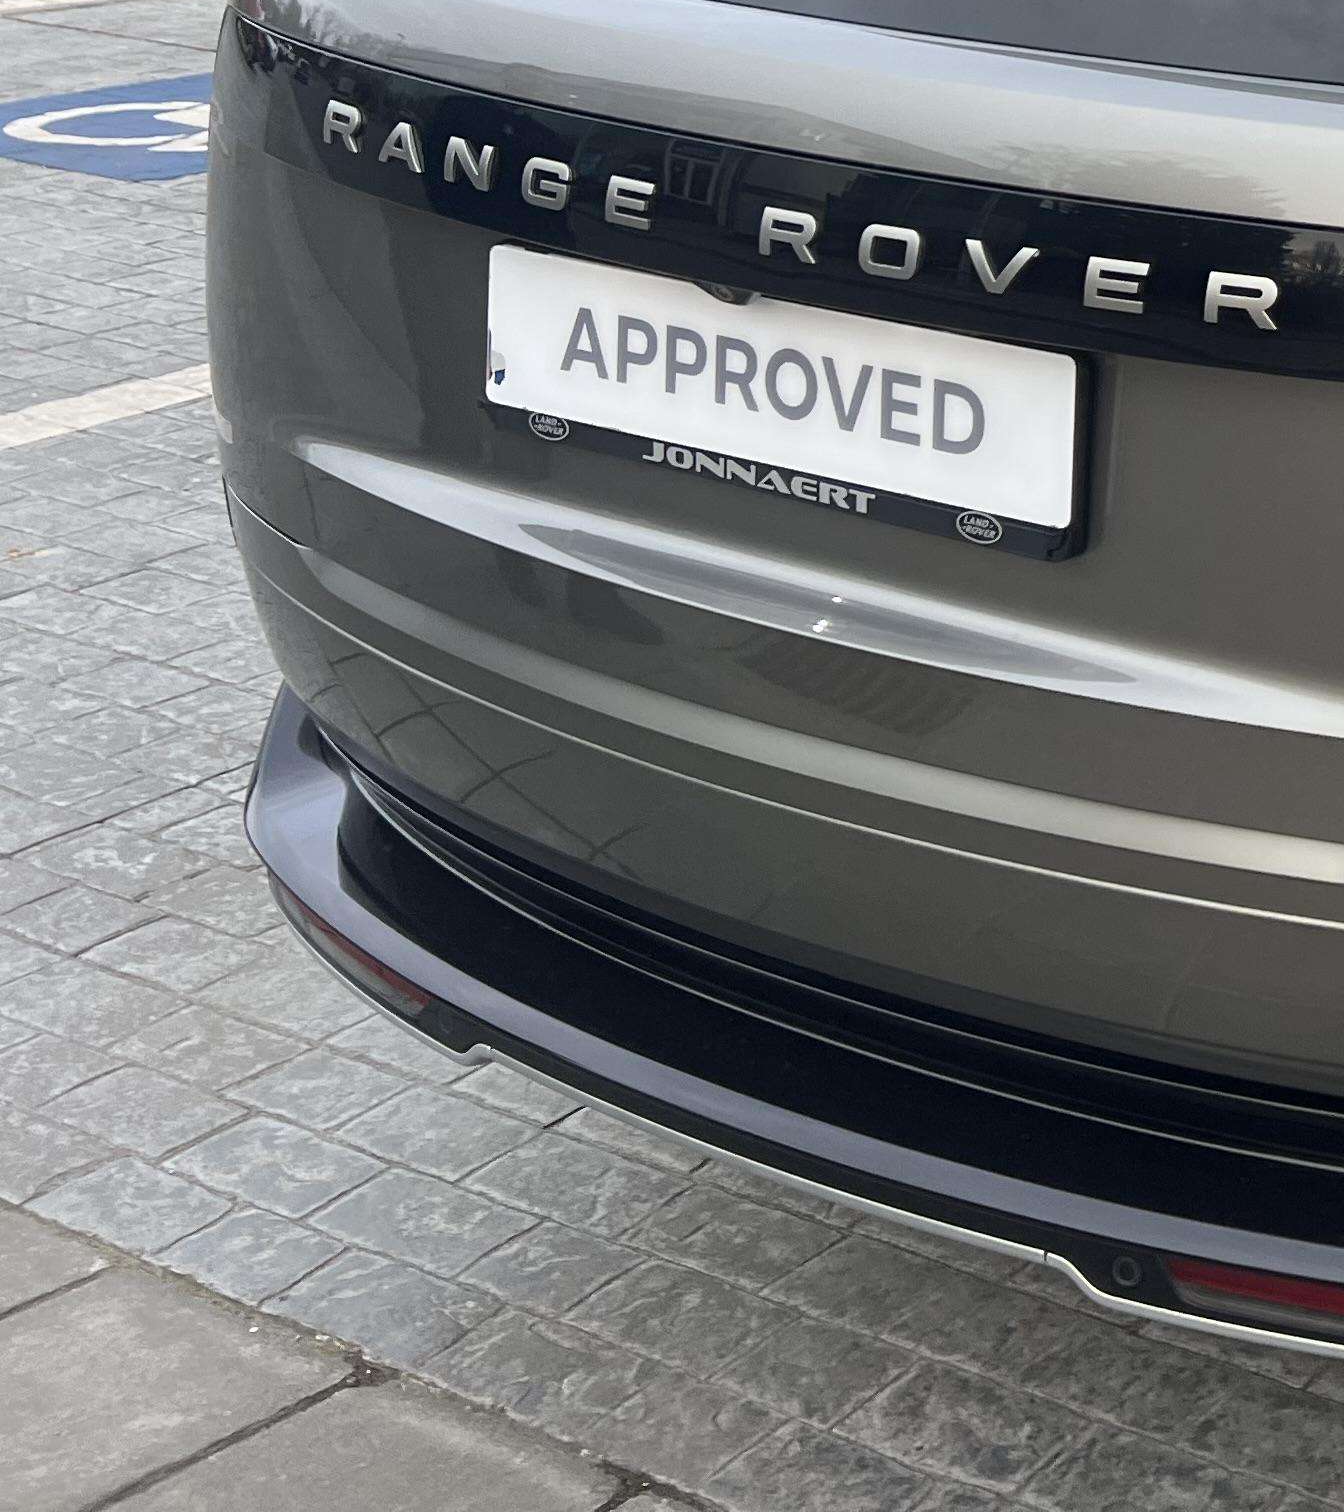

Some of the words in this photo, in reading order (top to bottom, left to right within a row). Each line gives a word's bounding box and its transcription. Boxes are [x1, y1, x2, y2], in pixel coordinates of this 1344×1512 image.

[321, 99, 656, 232] RANGE
[757, 204, 1279, 331] ROVER
[560, 306, 986, 457] APPROVED
[642, 441, 876, 514] JONNAERT
